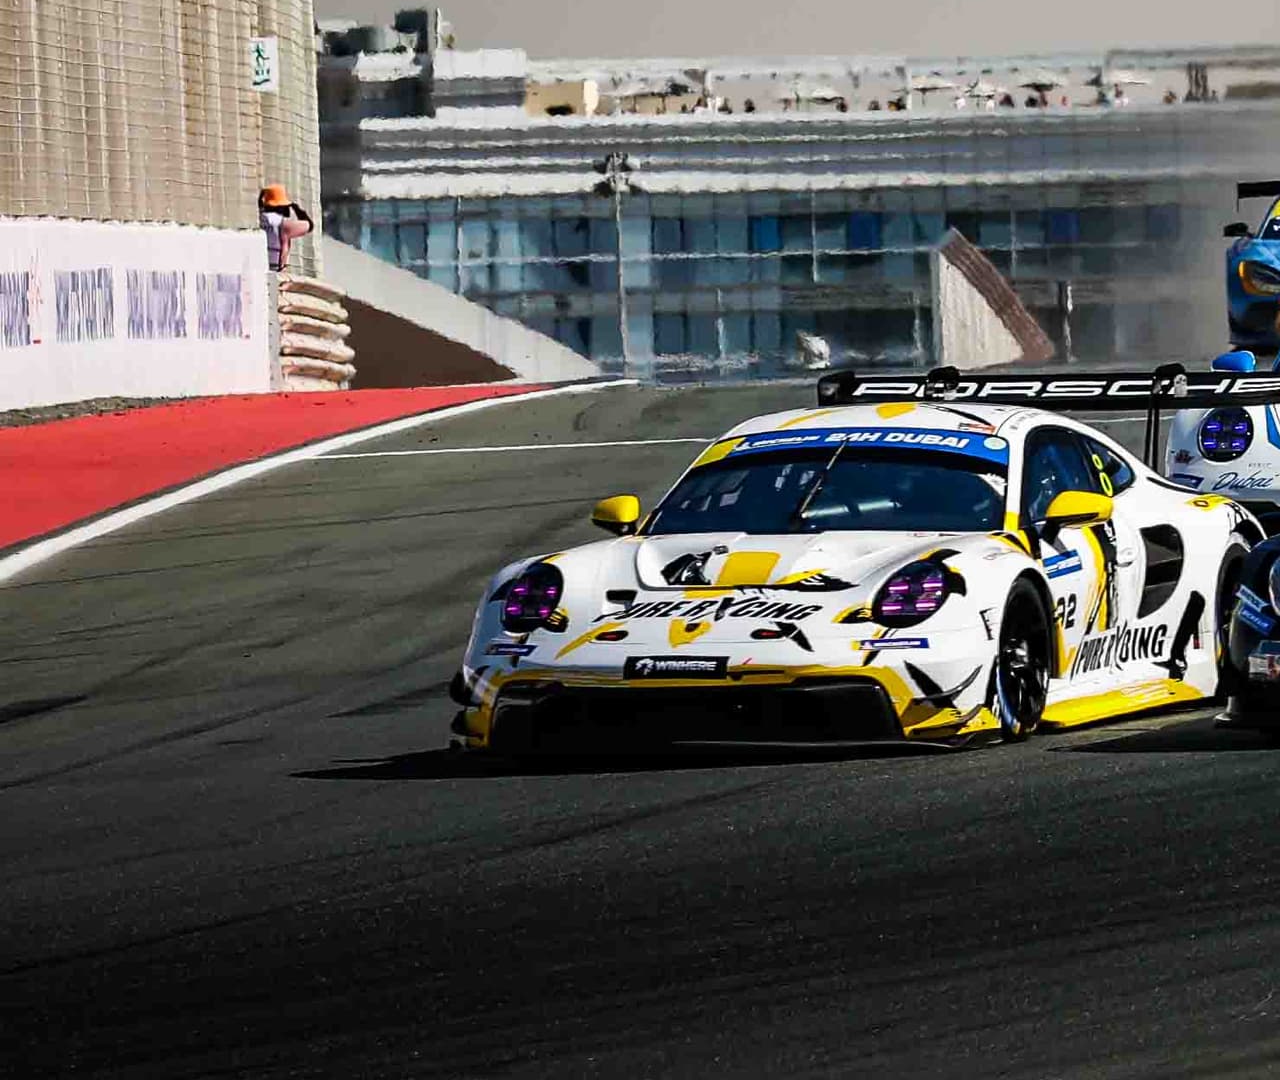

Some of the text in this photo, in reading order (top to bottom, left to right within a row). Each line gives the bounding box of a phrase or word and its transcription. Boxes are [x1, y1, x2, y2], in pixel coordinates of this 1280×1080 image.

[824, 432, 877, 443] 24H
[883, 432, 970, 449] DUBAI
[1211, 469, 1280, 491] Dubai
[654, 660, 717, 671] WINHERE
